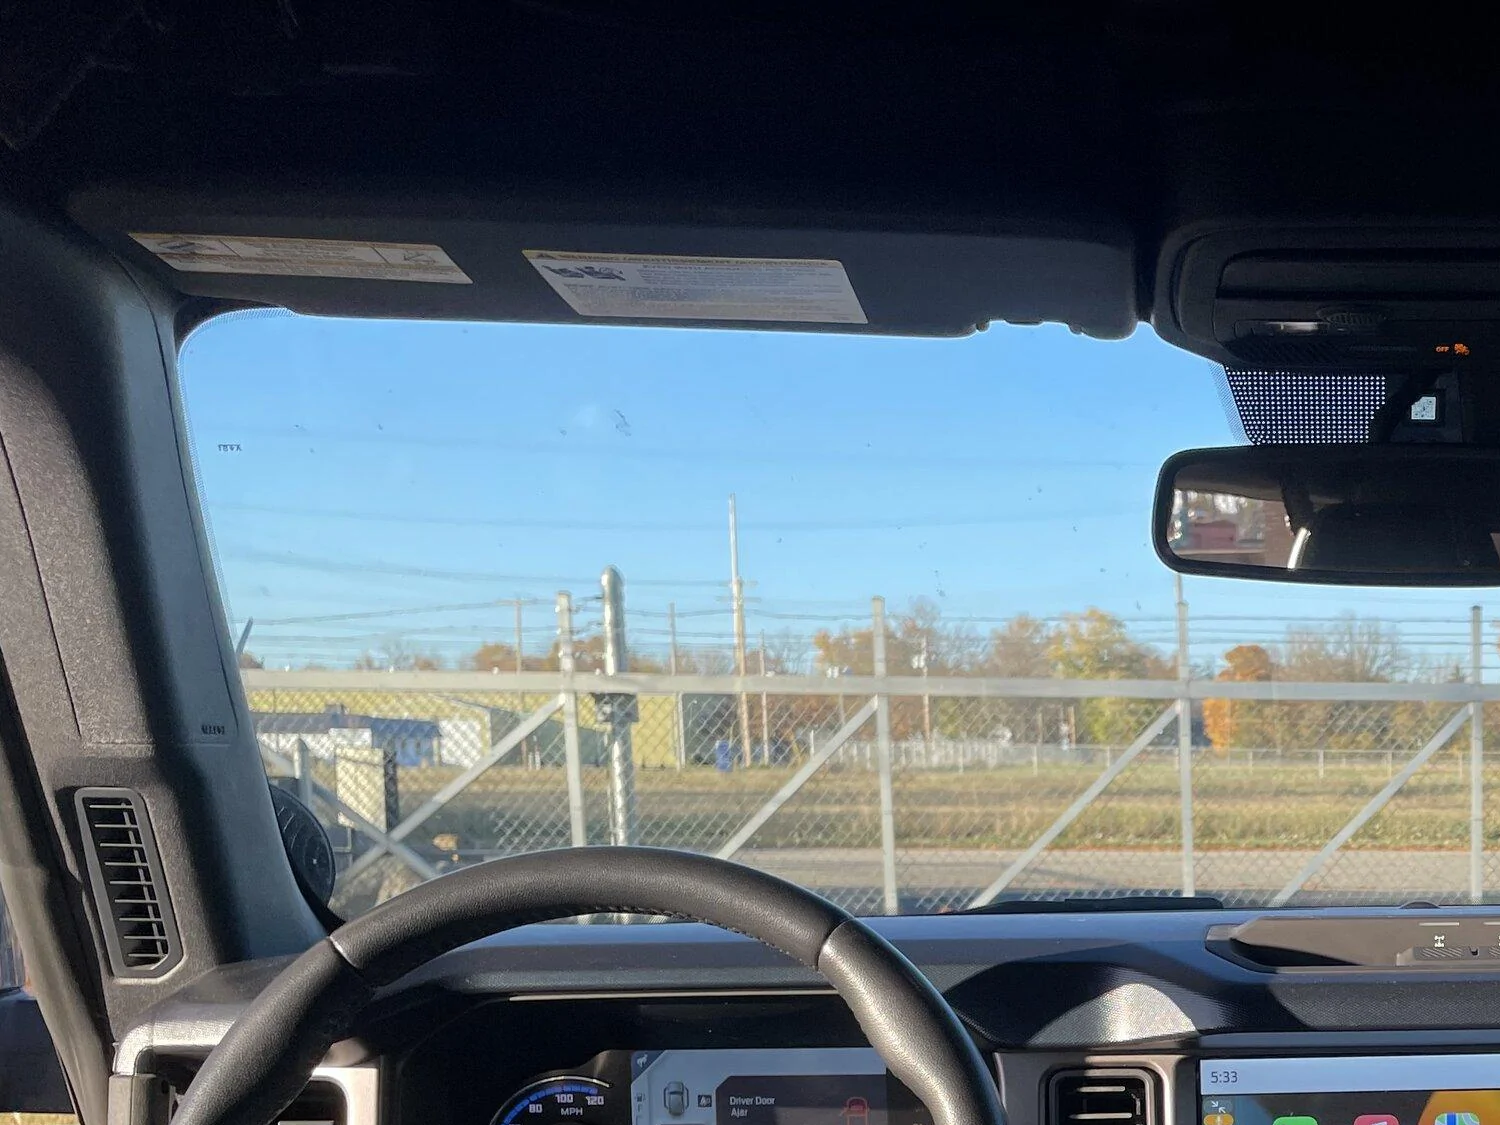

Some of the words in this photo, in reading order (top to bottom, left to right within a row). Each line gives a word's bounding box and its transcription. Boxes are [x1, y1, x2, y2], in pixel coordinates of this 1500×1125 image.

[1210, 1070, 1238, 1084] 5:33
[555, 1093, 574, 1104] 100
[585, 1095, 605, 1106] 120
[729, 1096, 753, 1105] Driver
[755, 1096, 775, 1105] Door
[529, 1103, 543, 1113] 80
[560, 1107, 583, 1116] MPH
[730, 1108, 748, 1118] Ajar
